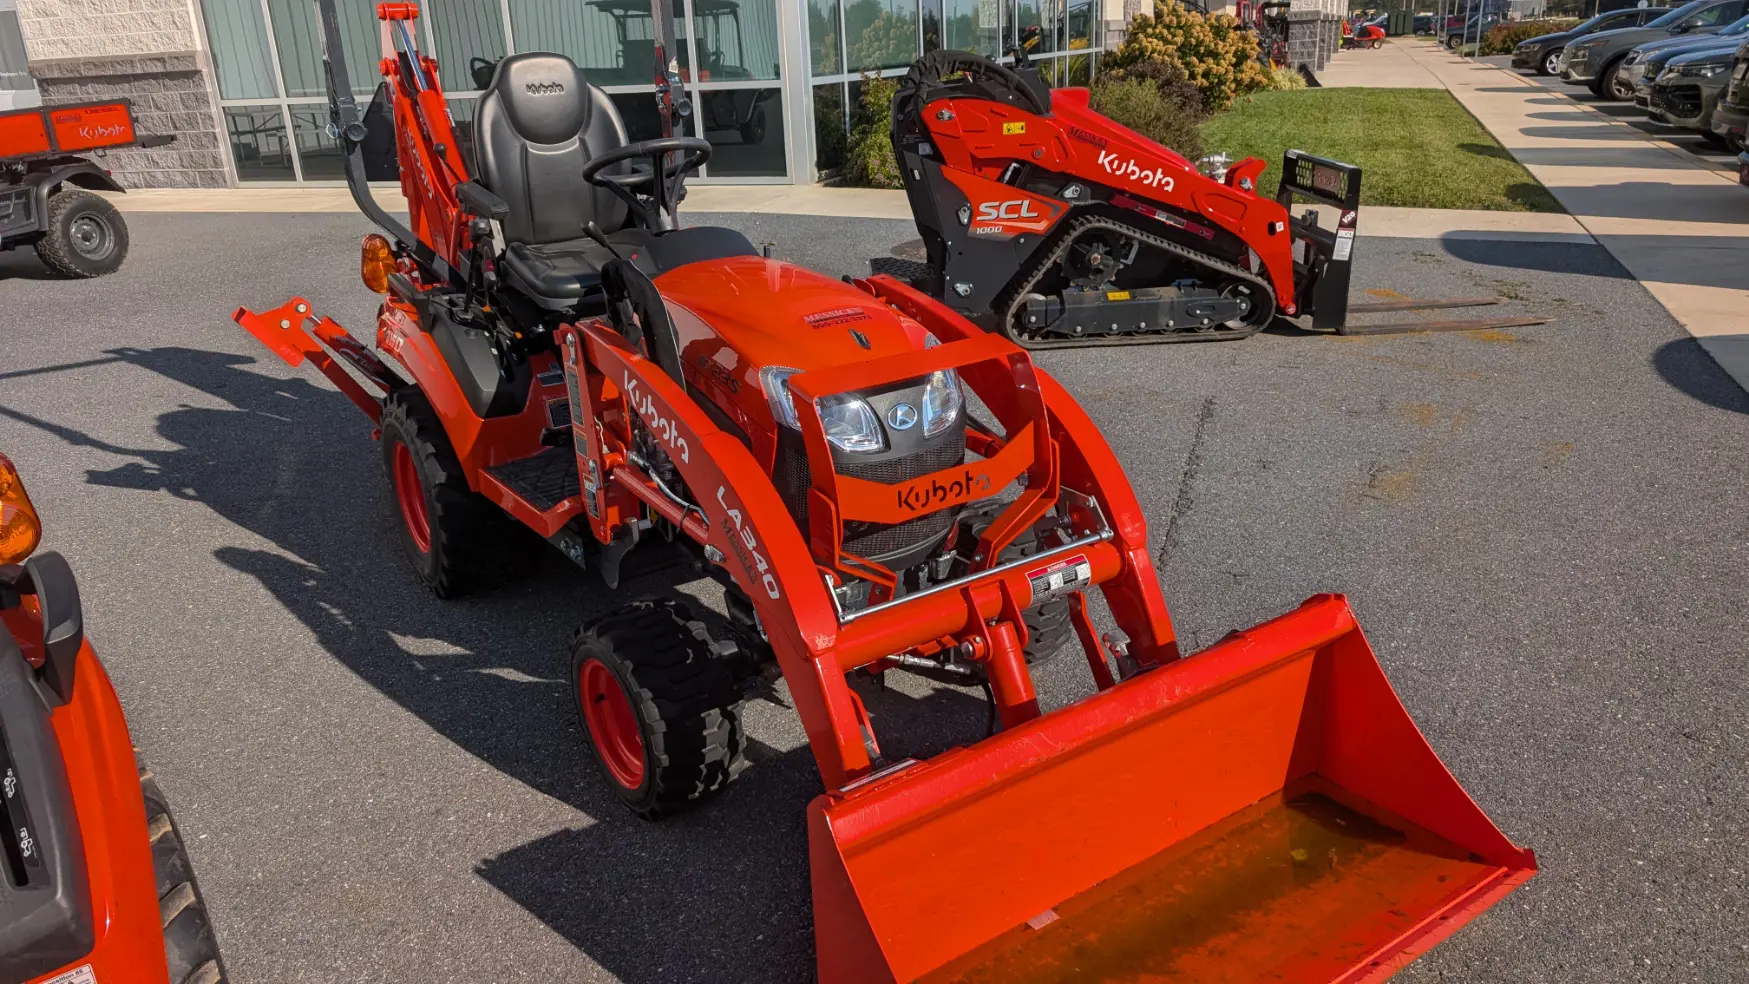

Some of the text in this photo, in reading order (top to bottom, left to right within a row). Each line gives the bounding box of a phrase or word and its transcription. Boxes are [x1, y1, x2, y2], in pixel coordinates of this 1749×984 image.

[525, 81, 565, 96] Kubota
[1097, 149, 1174, 193] Kubota
[976, 199, 1039, 221] SCL
[976, 225, 1003, 234] 1000
[624, 369, 689, 464] Kubota
[897, 470, 991, 511] Kubota
[716, 484, 780, 600] LA340
